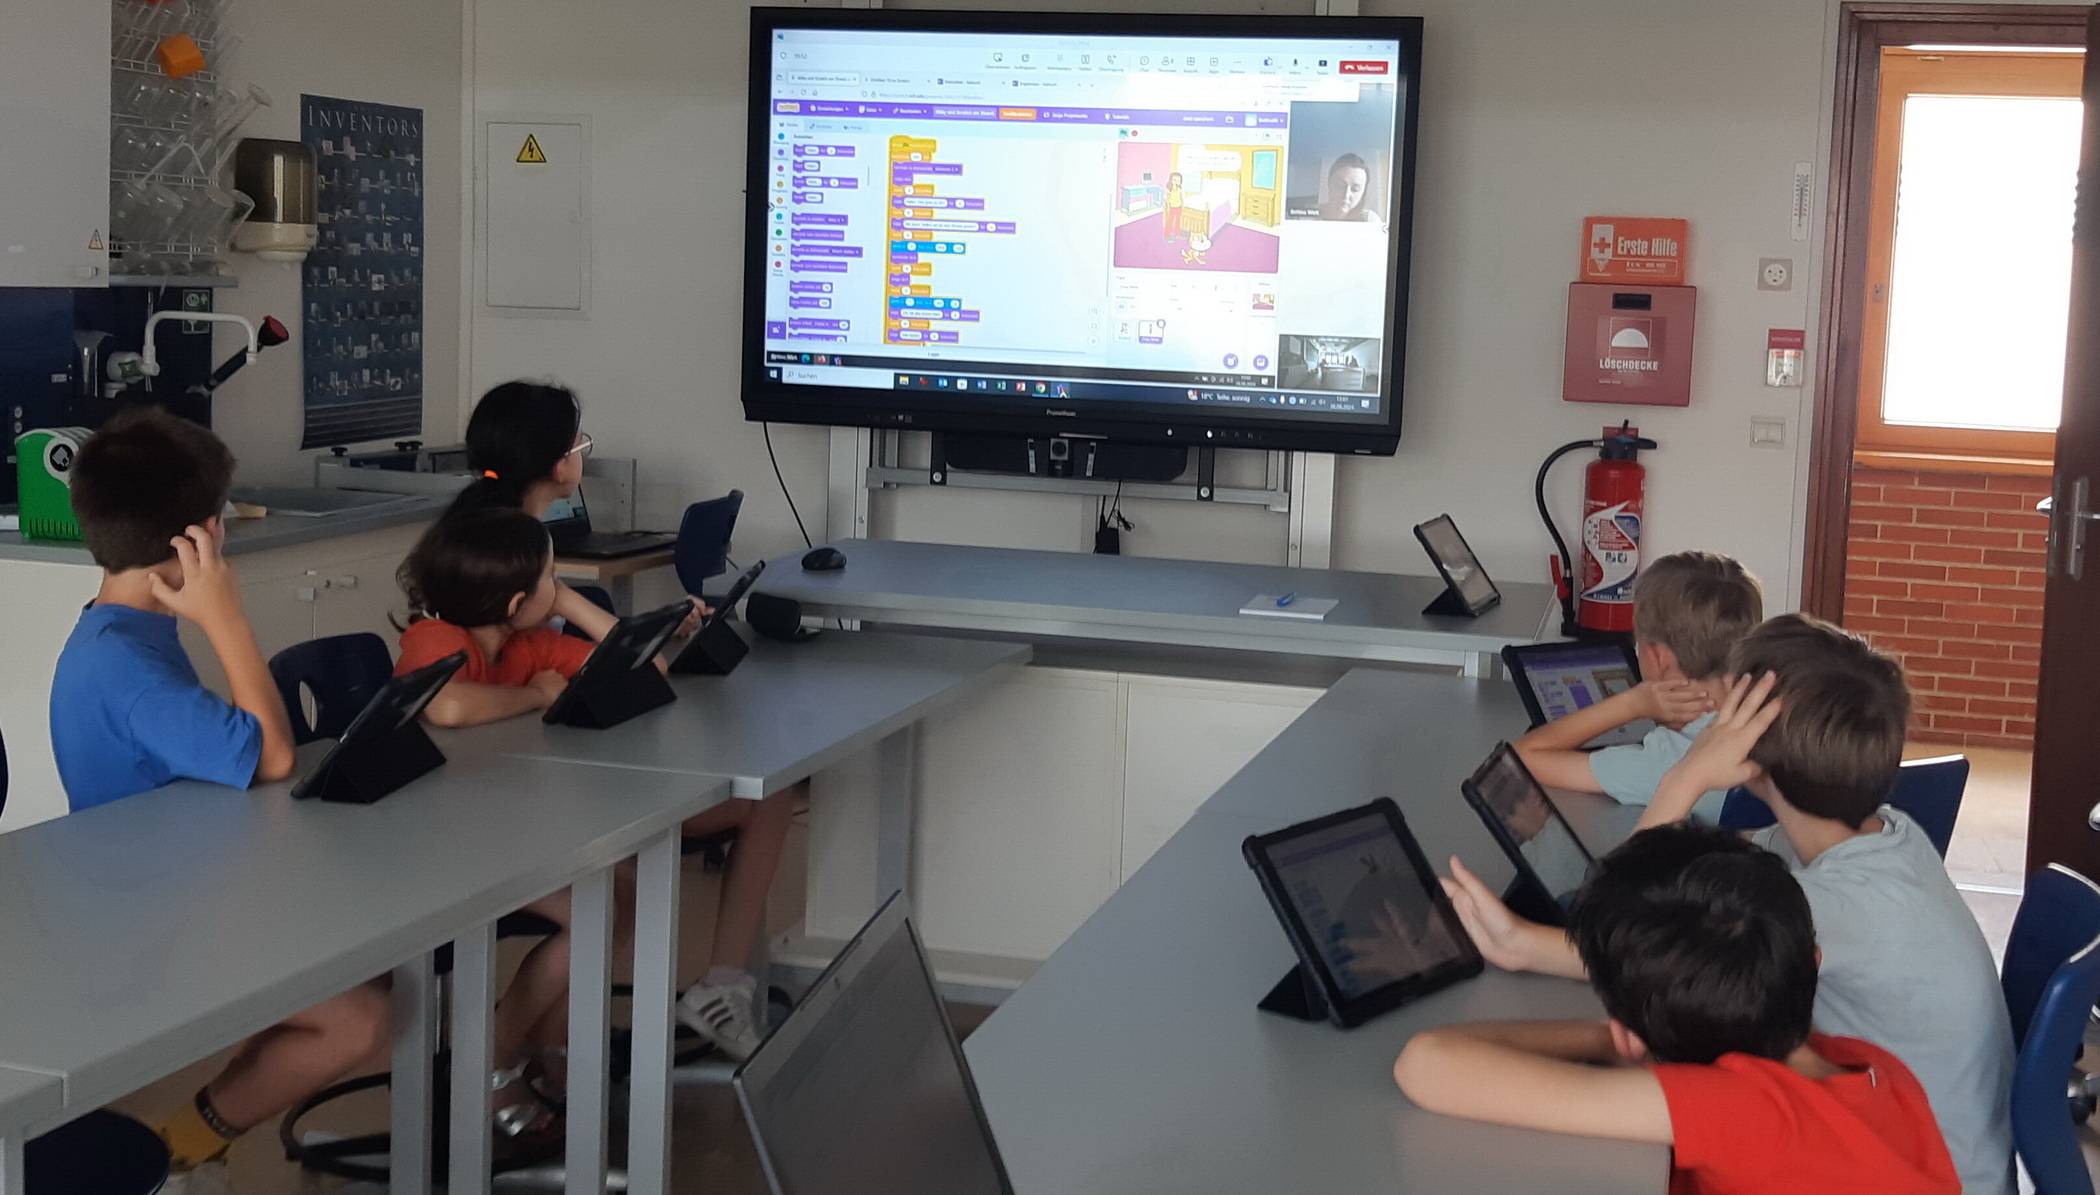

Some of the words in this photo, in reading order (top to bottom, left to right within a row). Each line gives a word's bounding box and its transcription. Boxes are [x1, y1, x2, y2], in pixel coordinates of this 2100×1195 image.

[1356, 64, 1385, 72] Verlassen
[308, 105, 418, 138] INVENTORS
[1617, 236, 1649, 256] Erste
[1651, 237, 1678, 257] Hilfe
[1599, 358, 1658, 371] LÖSCHDECKE
